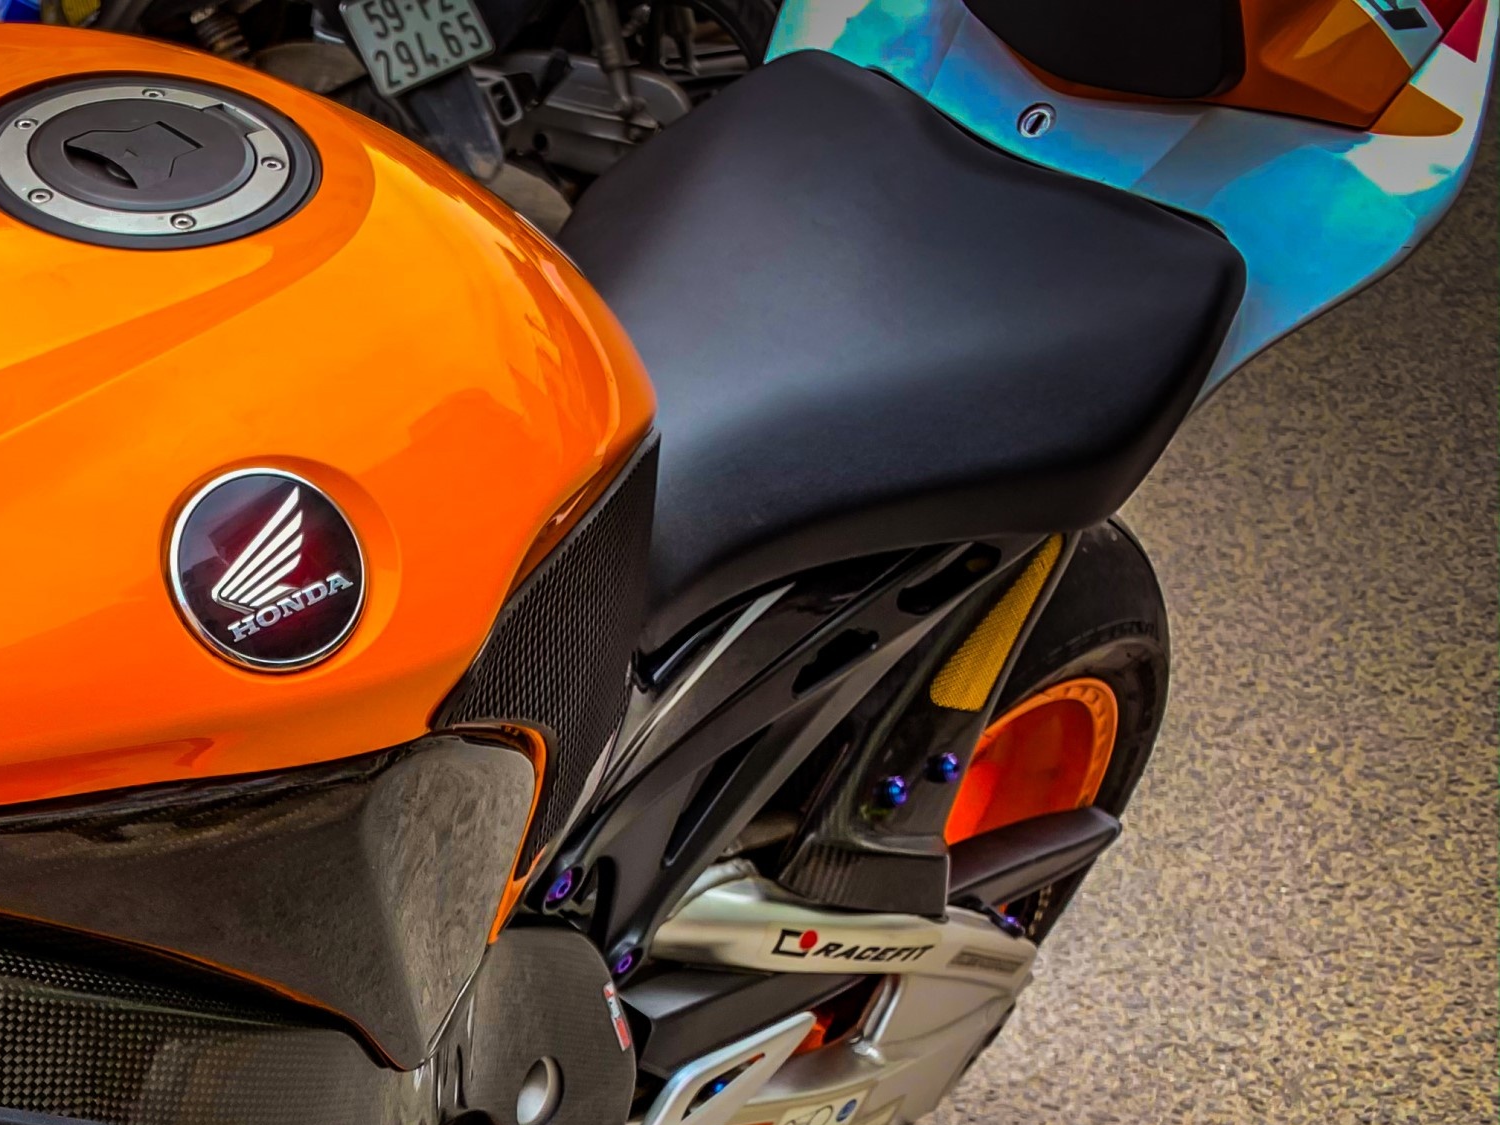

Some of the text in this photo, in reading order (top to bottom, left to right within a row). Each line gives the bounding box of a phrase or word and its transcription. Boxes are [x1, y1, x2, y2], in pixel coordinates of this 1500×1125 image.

[374, 11, 484, 88] 294.65
[227, 571, 354, 643] HONDA
[812, 941, 935, 962] RACEFIT
